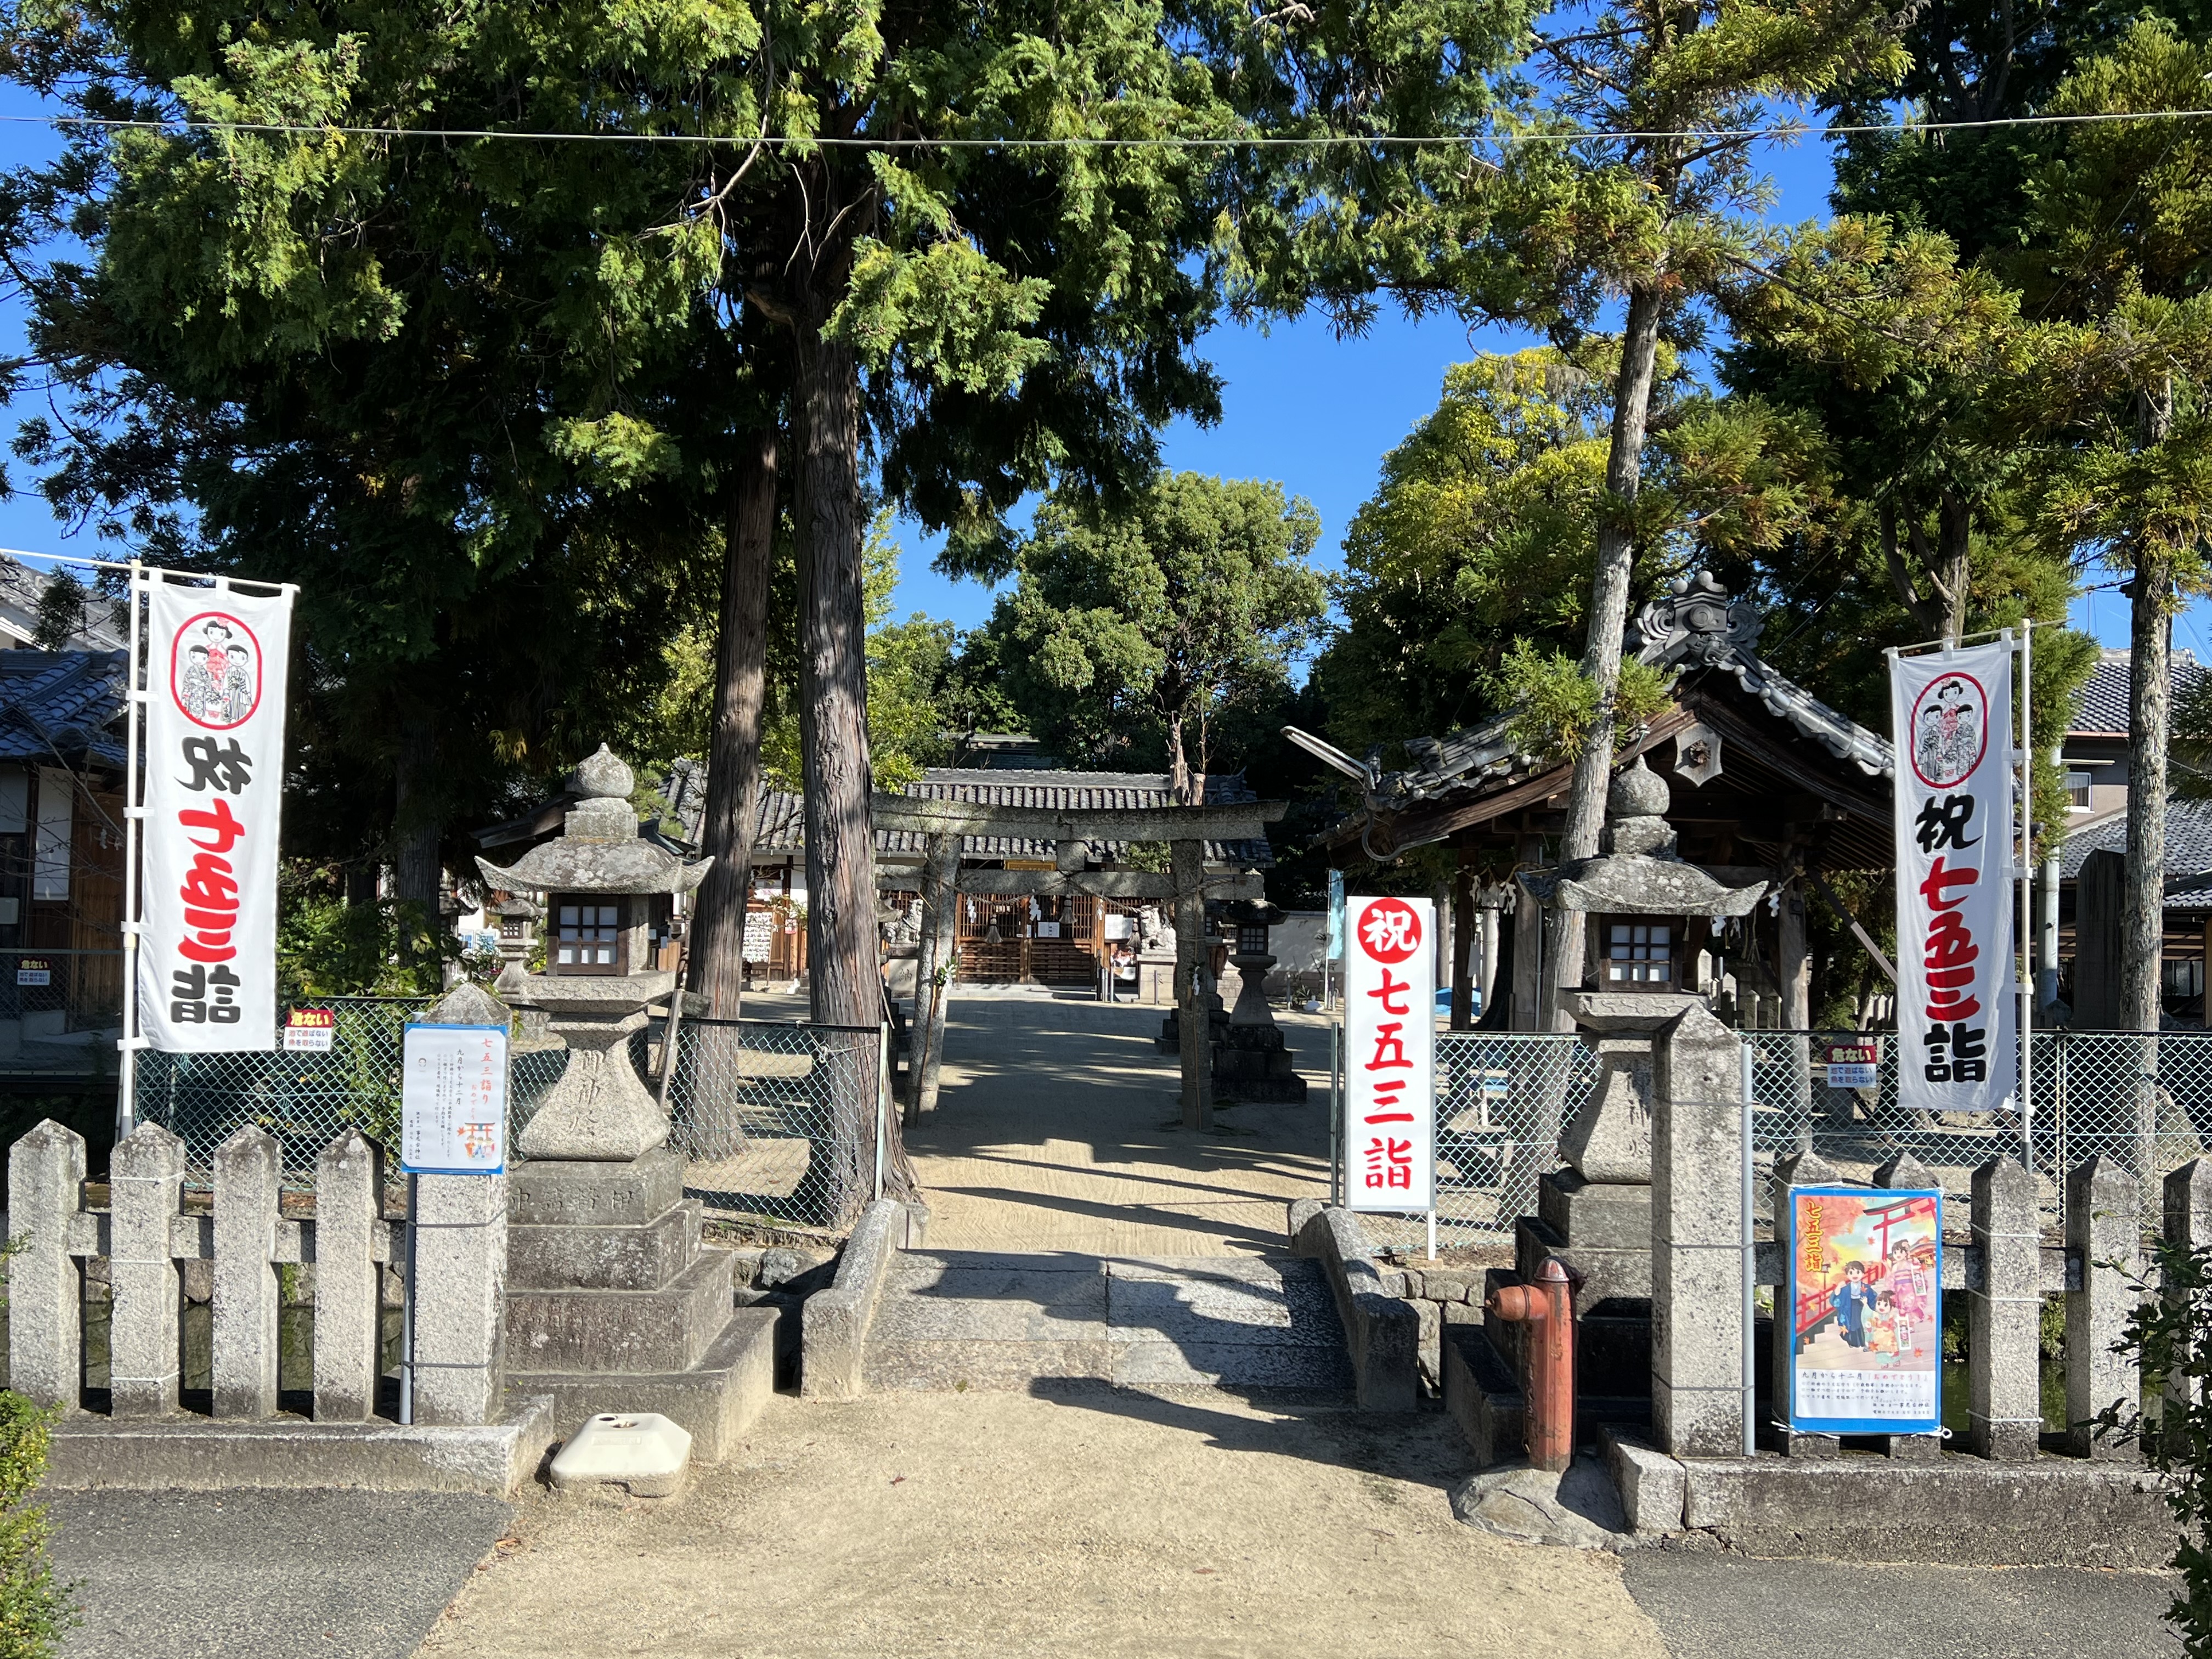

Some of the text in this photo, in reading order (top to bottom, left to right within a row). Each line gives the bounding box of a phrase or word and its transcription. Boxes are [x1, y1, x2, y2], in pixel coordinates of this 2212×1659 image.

[1915, 793, 1987, 1084] 祝七五三詣
[290, 1012, 329, 1026] 危ない
[1363, 909, 1418, 1190] 祝 七五三詣
[455, 1048, 465, 1105] 九月から十二月
[480, 1038, 493, 1104] 七五三詣り
[1831, 1048, 1871, 1063] 危ない
[1804, 1201, 1823, 1272] 七五三詣
[1802, 1371, 1863, 1380] 九月から十二月
